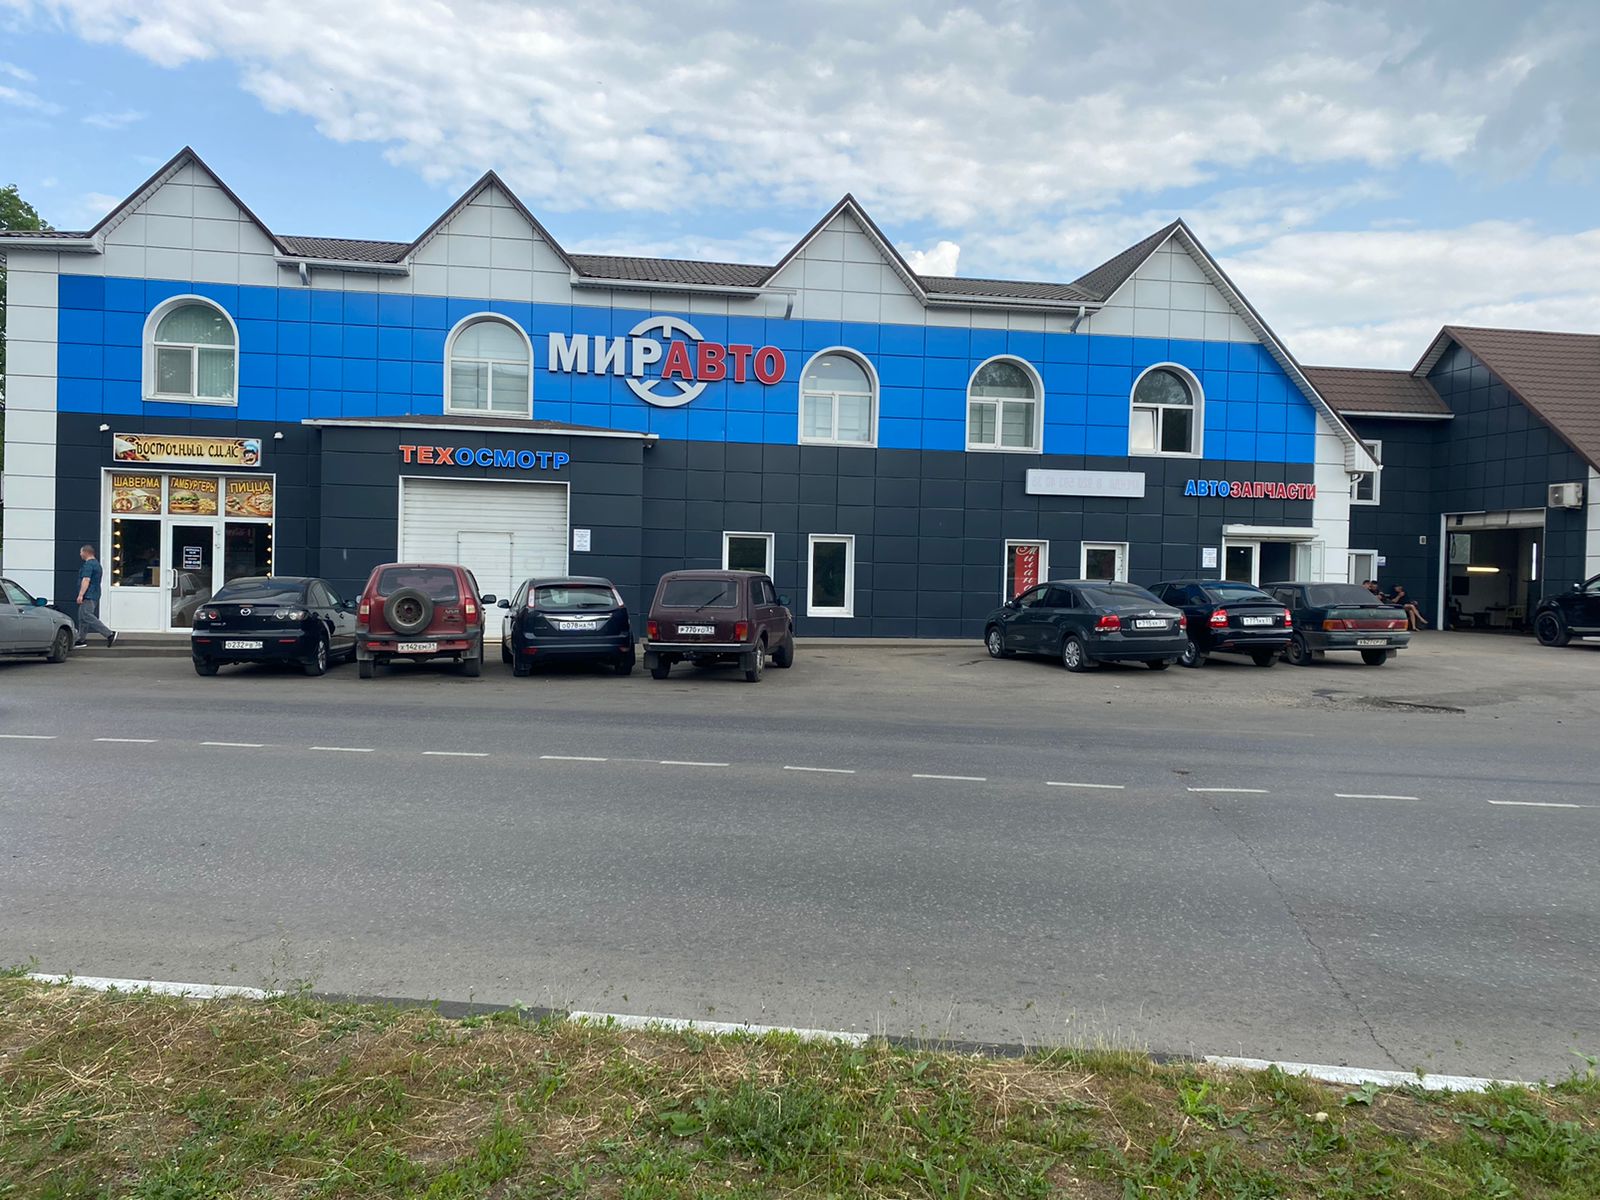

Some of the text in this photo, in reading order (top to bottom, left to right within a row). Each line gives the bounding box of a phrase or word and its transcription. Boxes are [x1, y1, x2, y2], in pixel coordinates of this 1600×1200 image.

[135, 441, 239, 458] ВОСТОЧНЫЙ СМАК
[399, 444, 570, 470] ТЕХОСМОТР
[113, 476, 160, 488] ШАВЕРМА
[170, 477, 217, 493] ГАМБУРГЕРЫ
[229, 481, 272, 494] ПИЦЦА
[1185, 479, 1316, 500] АВТОЗАПЧАСТИ
